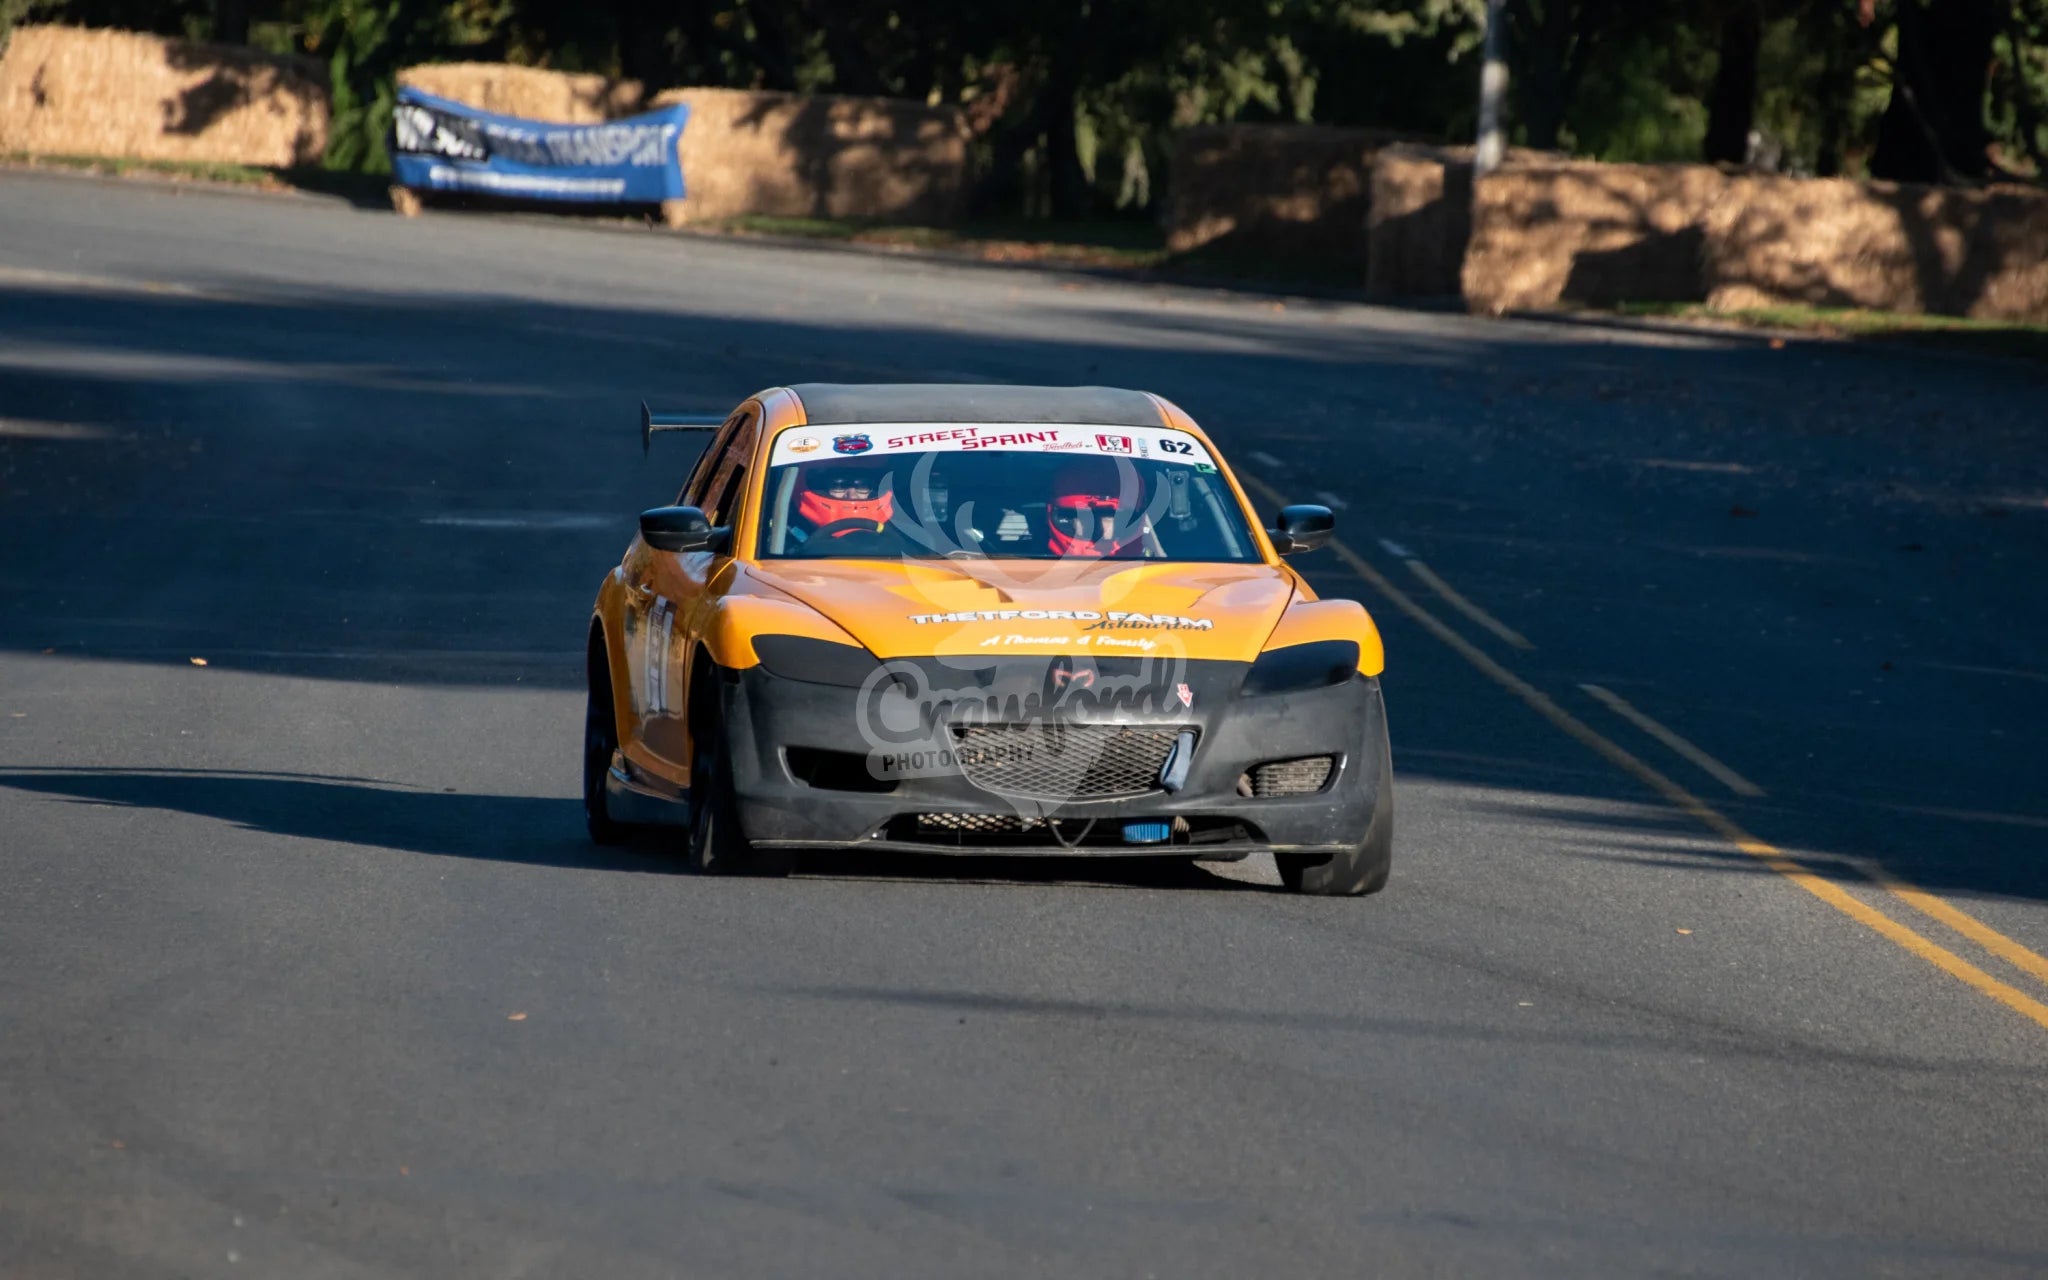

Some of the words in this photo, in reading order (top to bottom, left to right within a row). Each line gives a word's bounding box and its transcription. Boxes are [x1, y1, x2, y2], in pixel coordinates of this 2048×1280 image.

[887, 427, 979, 449] STREET
[961, 430, 1059, 450] SPRINT
[1159, 438, 1195, 456] 62
[907, 609, 1103, 624] THETFORD
[1106, 611, 1214, 630] FARM
[1082, 620, 1209, 632] Ashburton
[979, 635, 1001, 647] A
[1003, 634, 1070, 646] Thomas
[1096, 635, 1158, 651] Family
